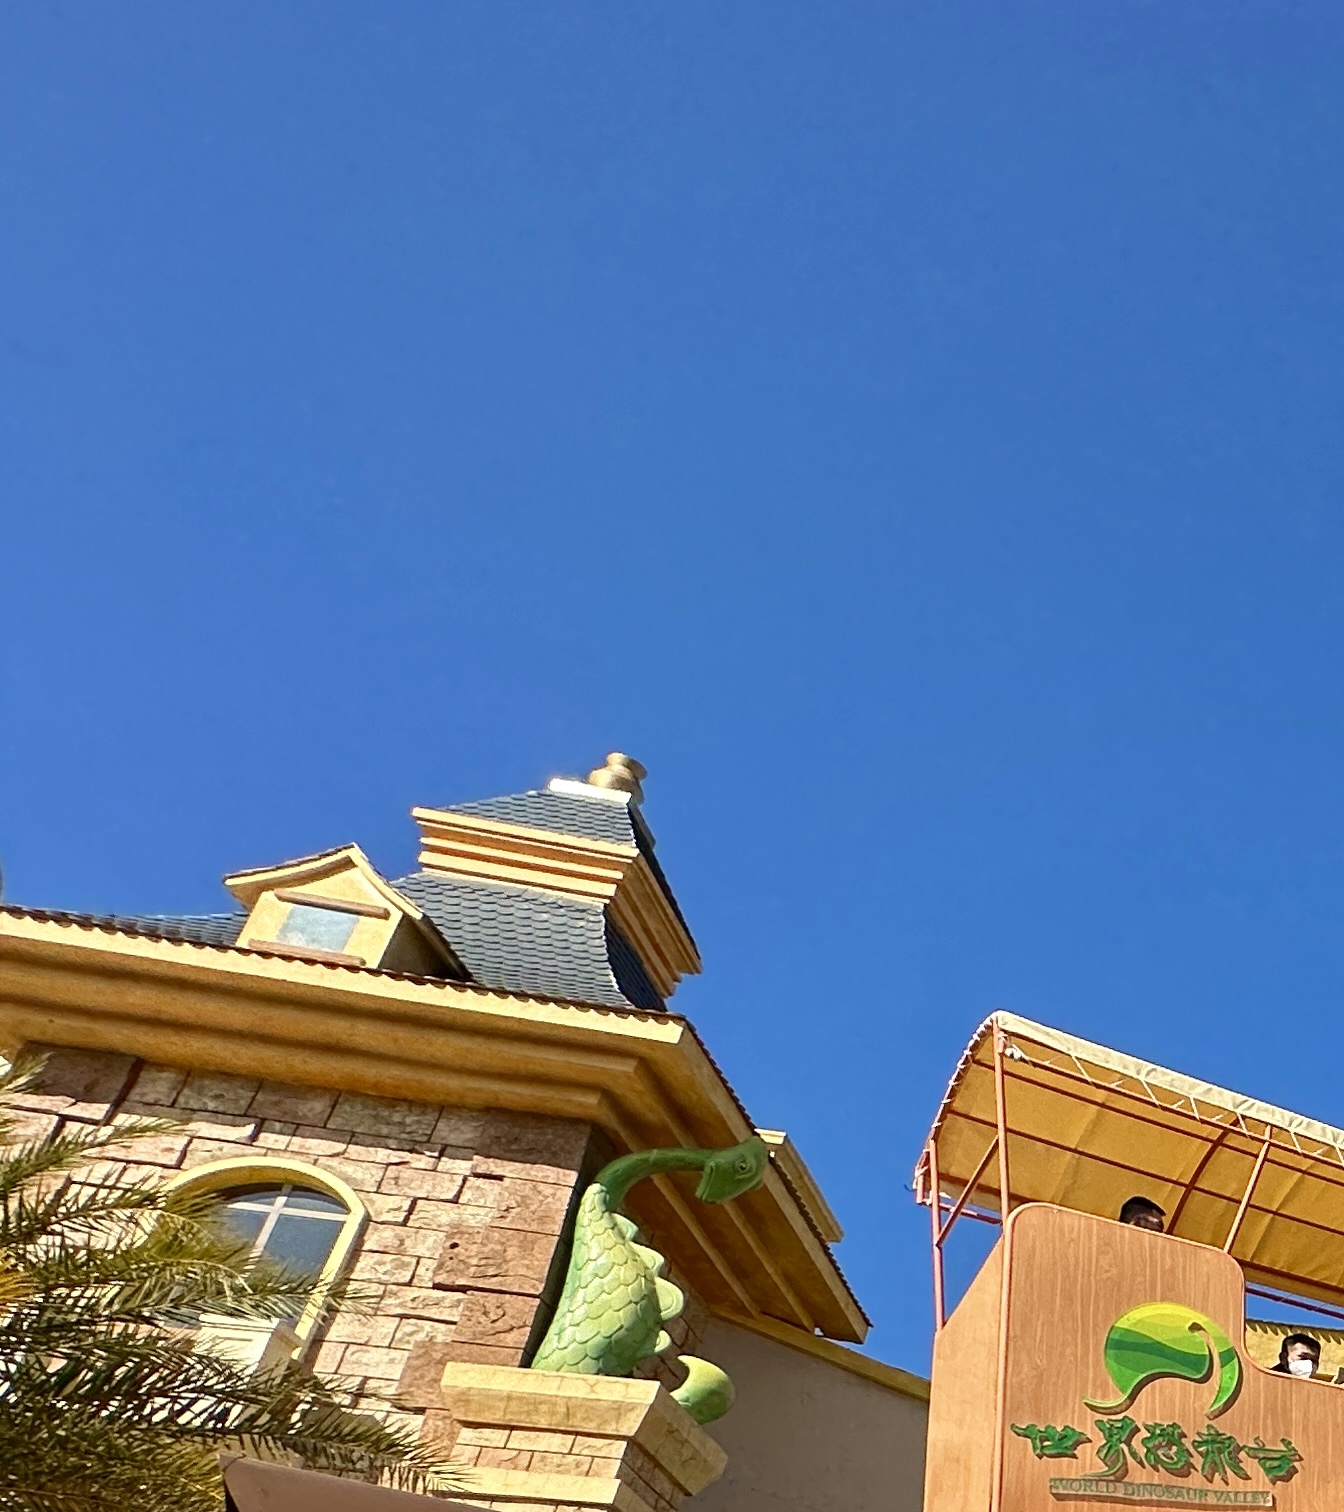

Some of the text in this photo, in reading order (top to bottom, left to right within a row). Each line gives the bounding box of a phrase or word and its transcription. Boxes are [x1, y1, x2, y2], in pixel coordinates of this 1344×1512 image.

[1050, 1479, 1273, 1506] WORLD DINOSAUR VALLEY
